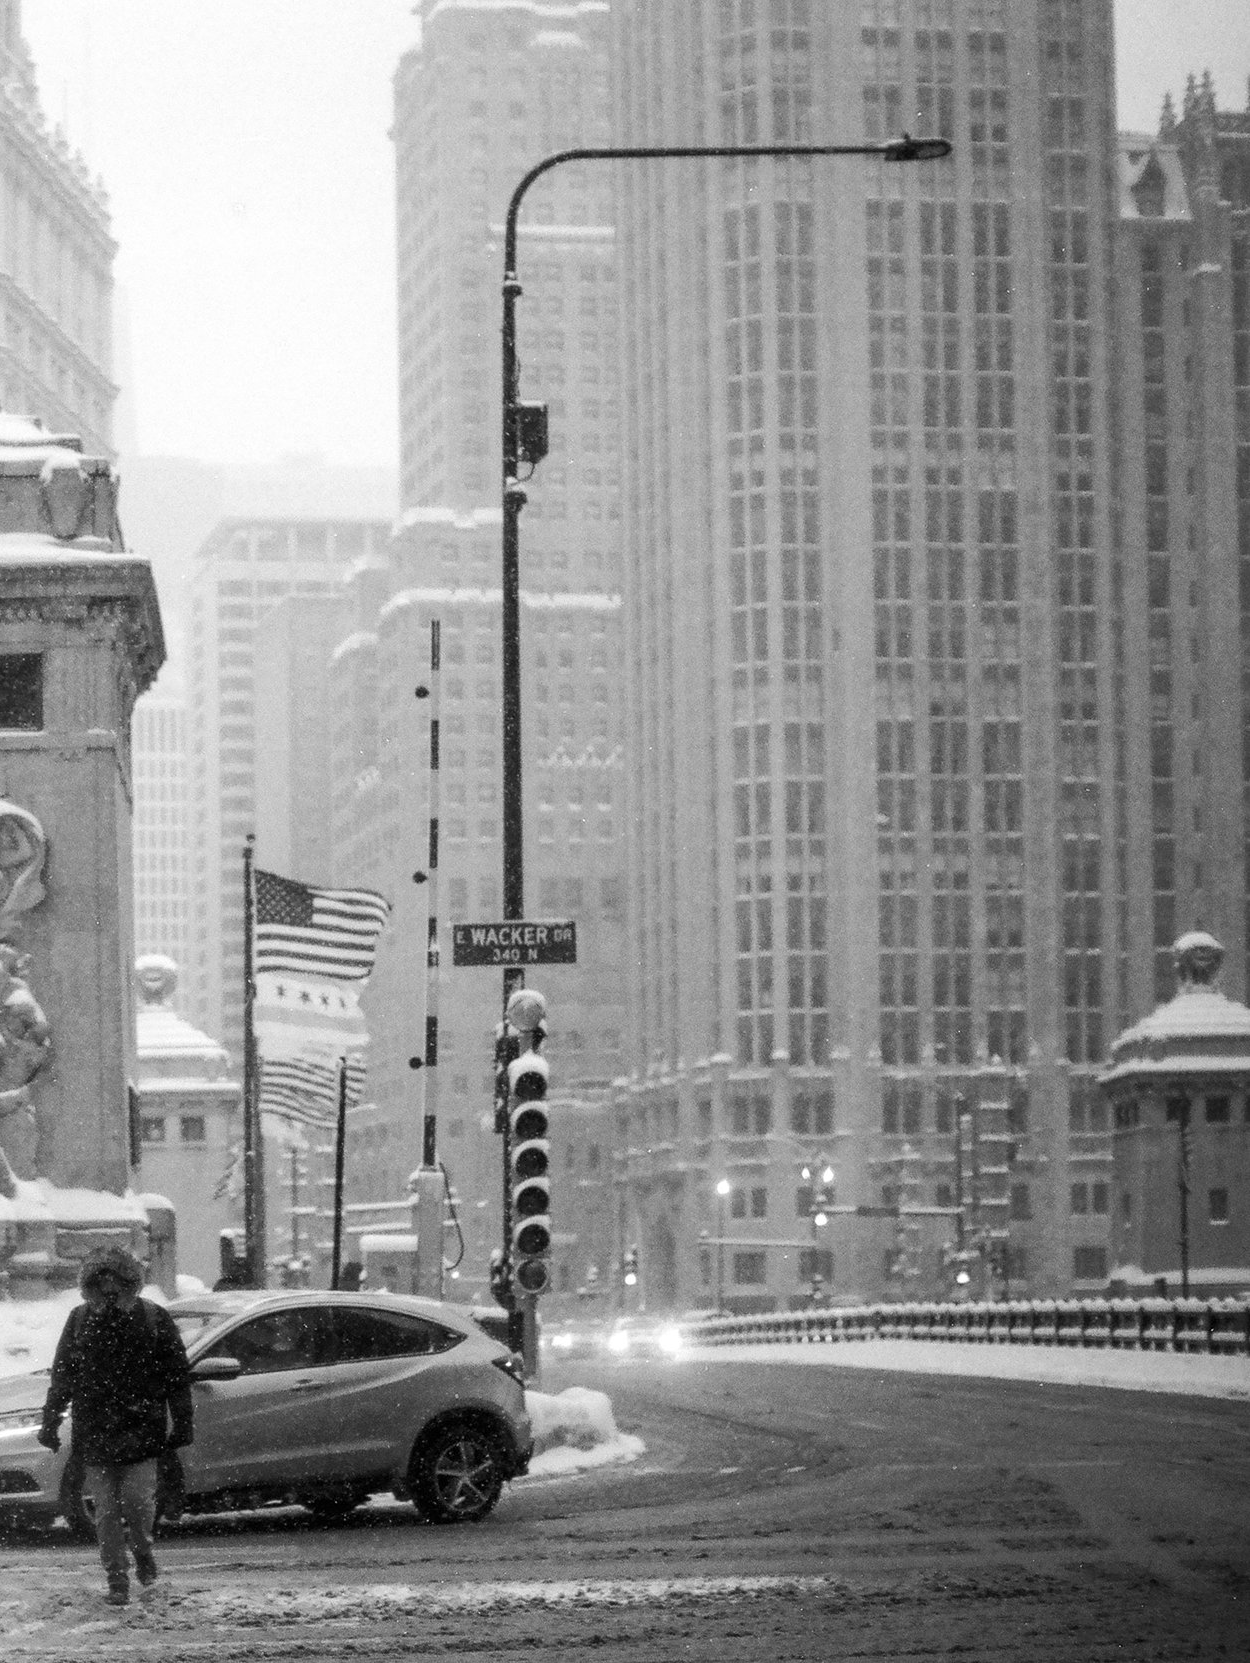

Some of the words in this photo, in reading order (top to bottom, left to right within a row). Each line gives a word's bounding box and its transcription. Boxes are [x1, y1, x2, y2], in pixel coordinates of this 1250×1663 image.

[456, 931, 465, 944] E
[470, 927, 548, 946] WACKER
[554, 929, 572, 942] DR
[493, 948, 521, 961] 340
[528, 948, 538, 960] N
